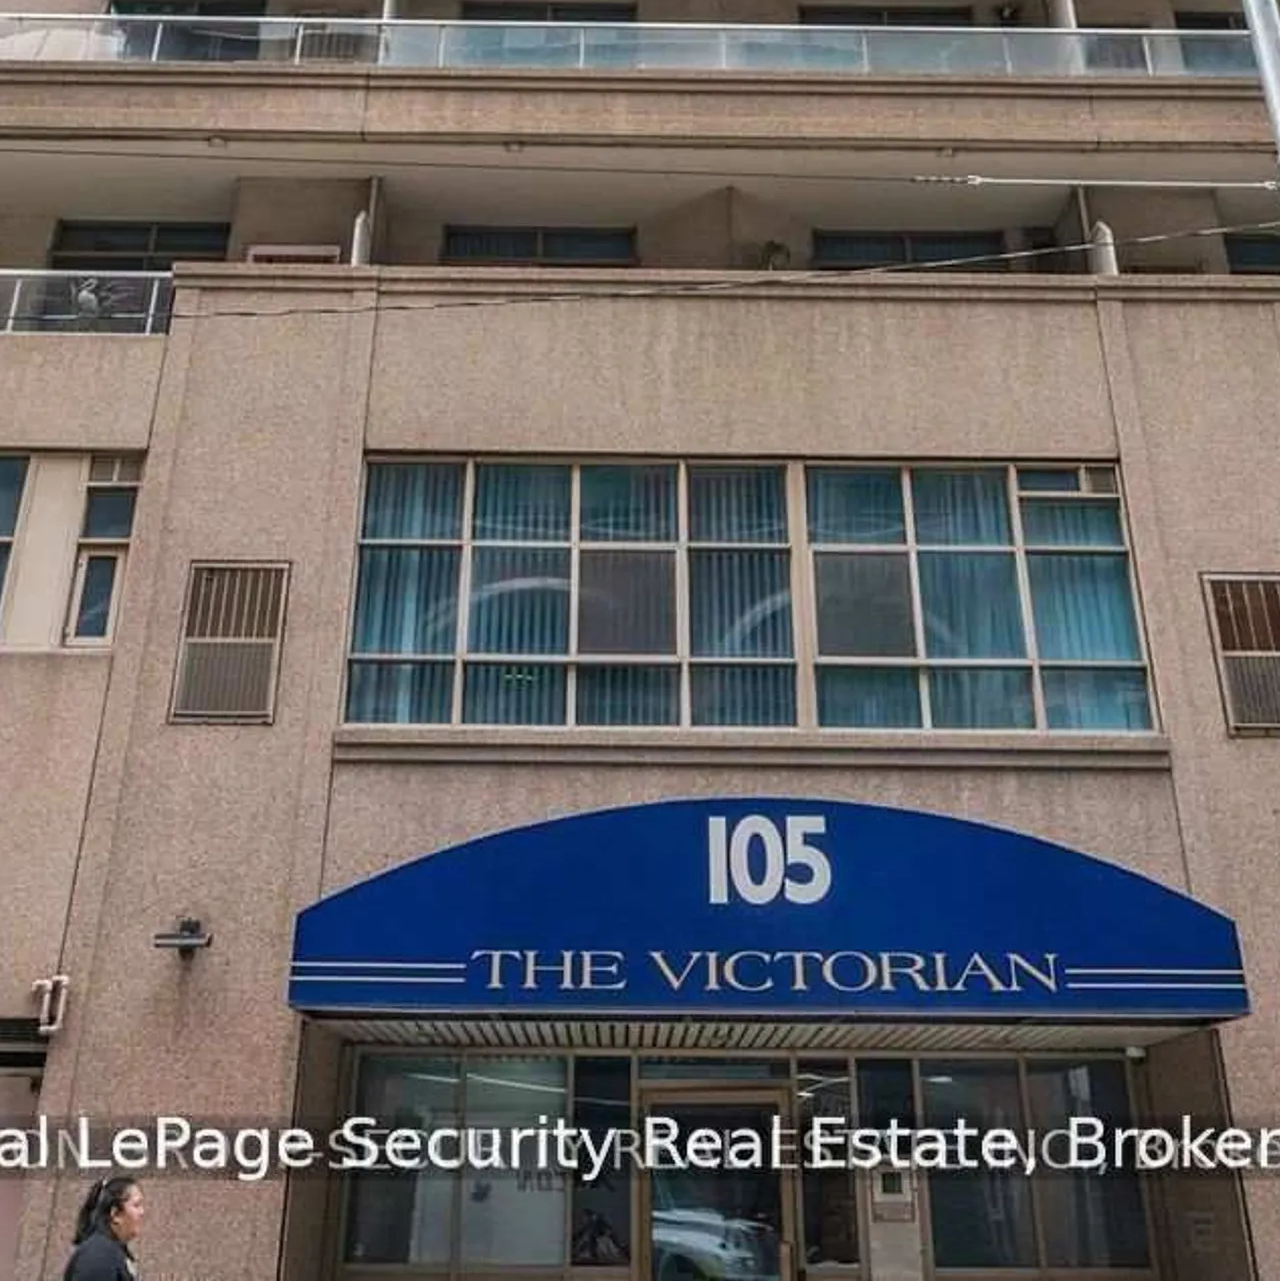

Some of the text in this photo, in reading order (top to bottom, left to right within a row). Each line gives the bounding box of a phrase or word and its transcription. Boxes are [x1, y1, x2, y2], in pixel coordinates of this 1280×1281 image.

[708, 815, 831, 905] 105
[470, 950, 1060, 993] THE VICTORIAN
